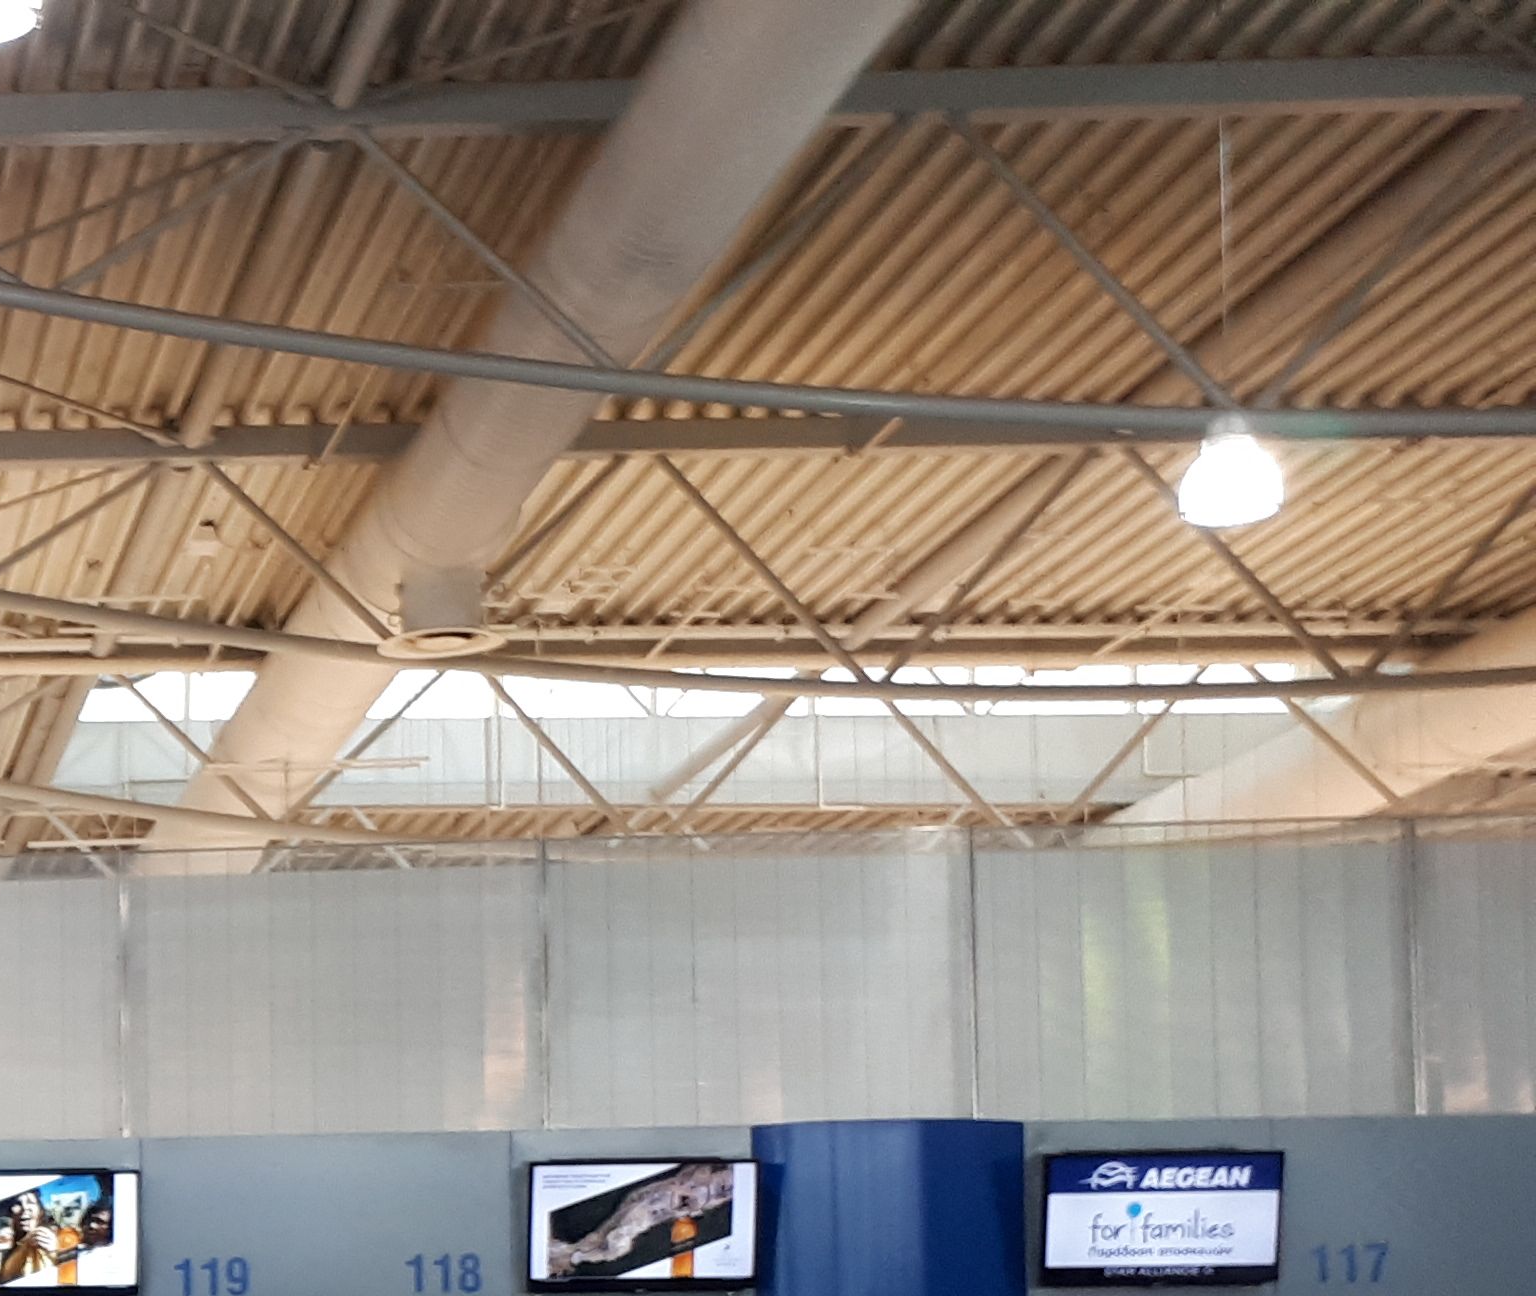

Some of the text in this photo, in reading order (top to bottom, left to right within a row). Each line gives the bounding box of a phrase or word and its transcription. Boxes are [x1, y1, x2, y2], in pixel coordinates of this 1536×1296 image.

[1138, 1164, 1254, 1190] AEGEAN
[1087, 1207, 1236, 1244] for families
[404, 1252, 483, 1294] 118
[1311, 1242, 1390, 1285] 117
